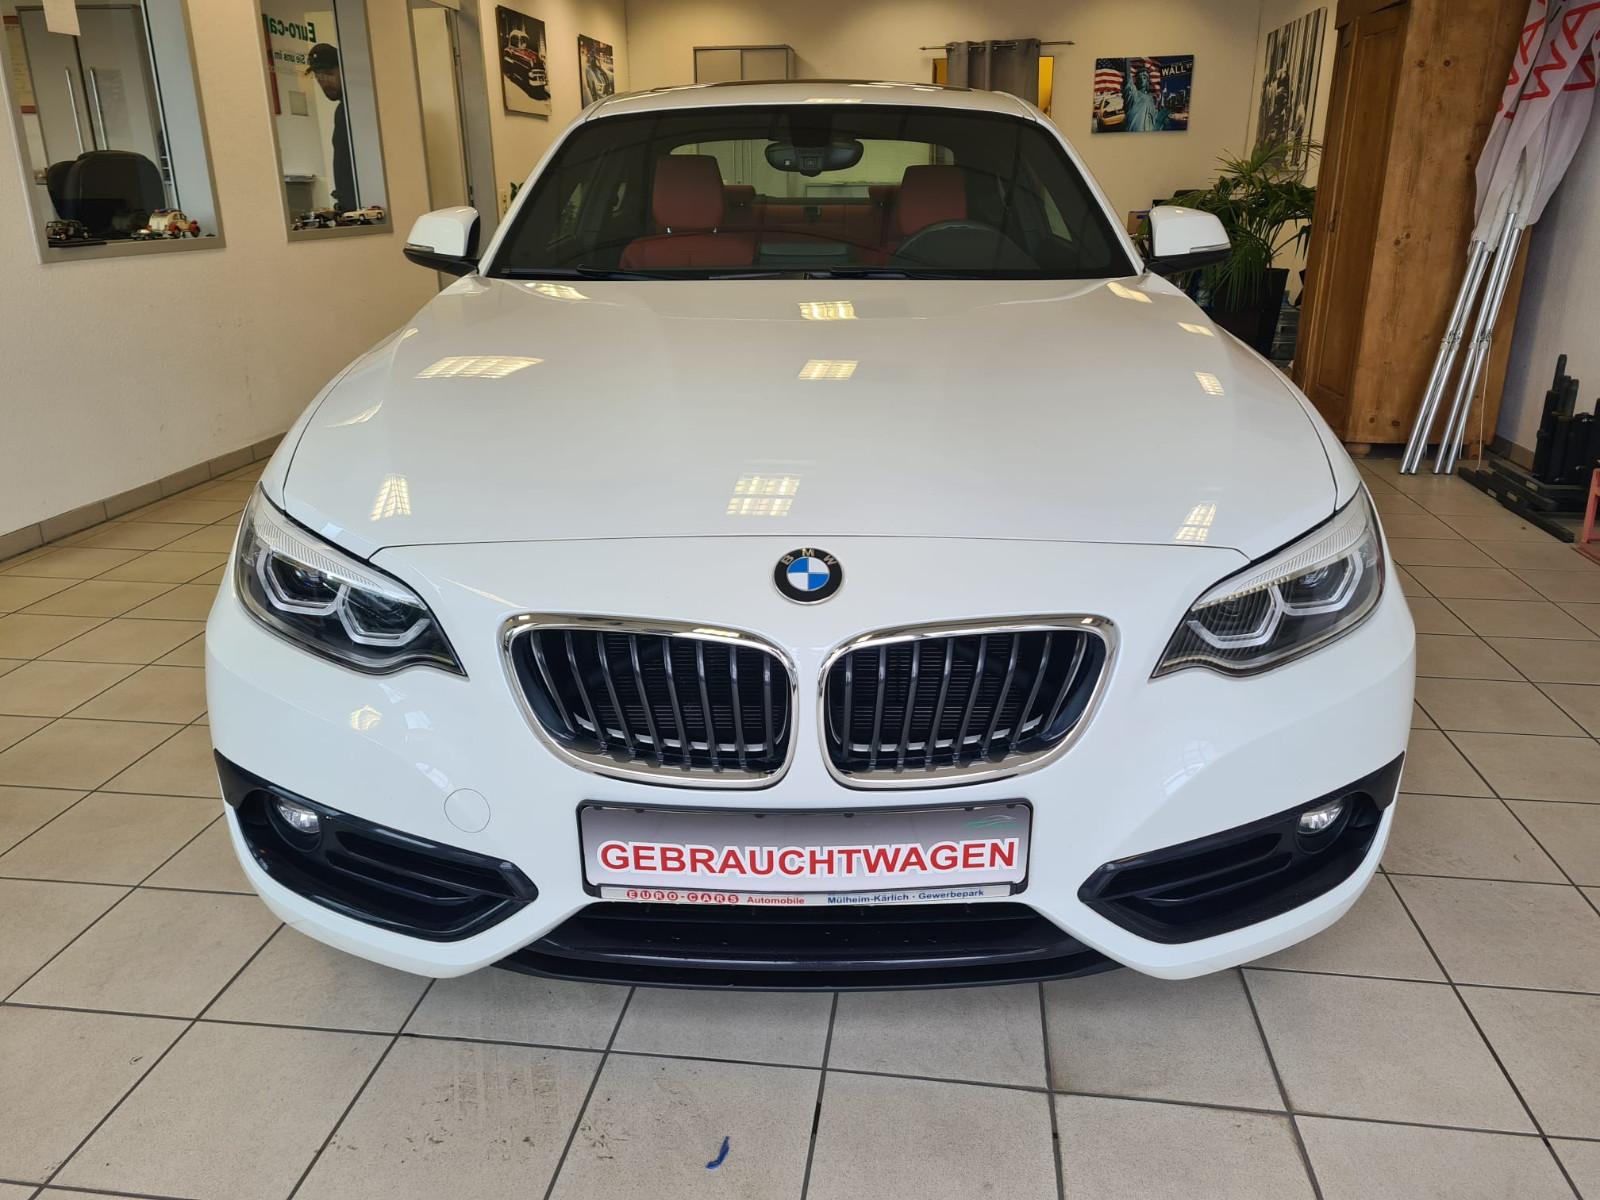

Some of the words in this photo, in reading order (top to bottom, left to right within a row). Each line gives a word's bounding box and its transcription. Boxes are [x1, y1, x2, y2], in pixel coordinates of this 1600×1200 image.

[1161, 65, 1186, 77] WALL
[781, 548, 838, 566] BMW
[600, 841, 1015, 875] GEBRAUCHTWAGEN
[626, 889, 740, 904] EURO-CARS
[747, 896, 805, 905] Automobile
[827, 893, 909, 905] Mülheim-Kärlich
[918, 889, 985, 901] Gewerbepark
